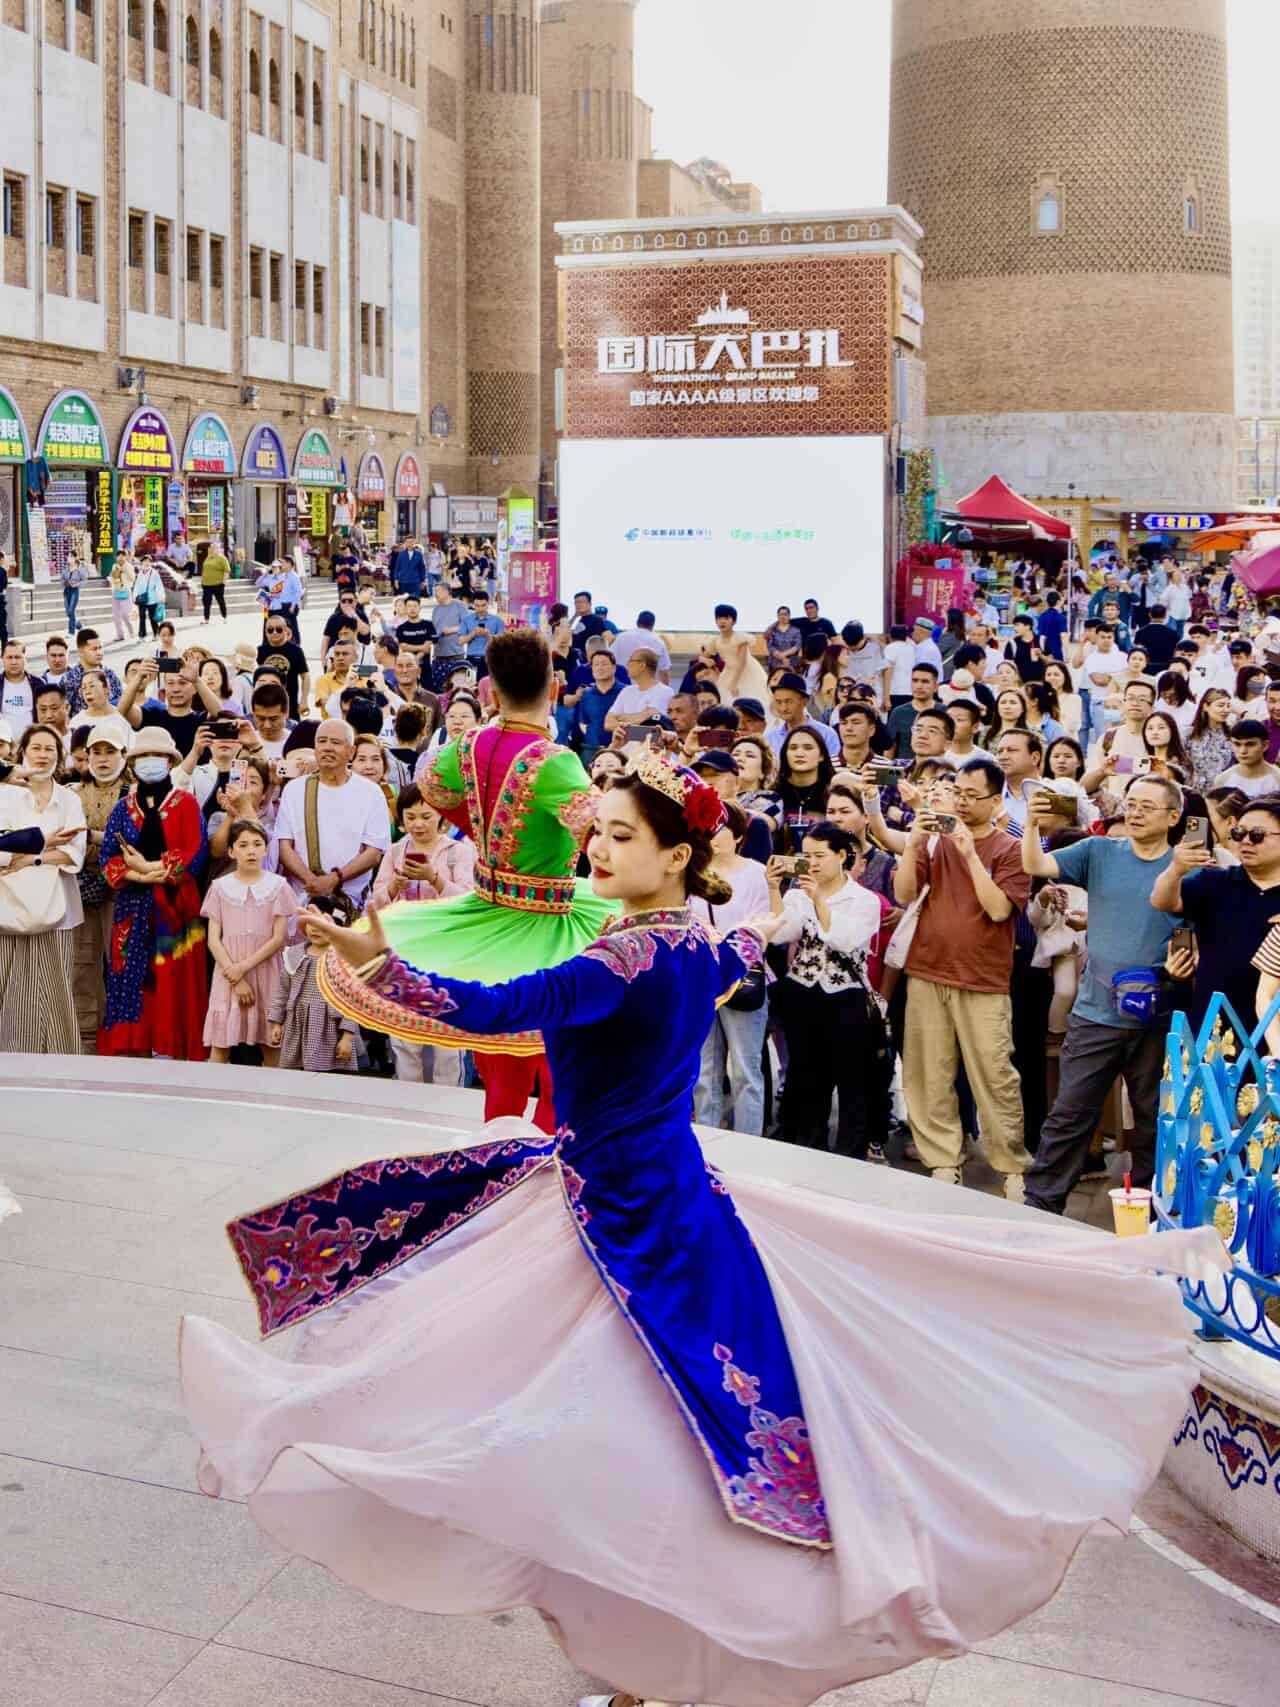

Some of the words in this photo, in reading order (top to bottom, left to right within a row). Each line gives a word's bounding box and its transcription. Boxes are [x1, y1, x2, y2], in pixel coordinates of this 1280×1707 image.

[597, 328, 855, 374] 国际大巴扎
[630, 385, 819, 407] 国家AAAA级景区欢迎您
